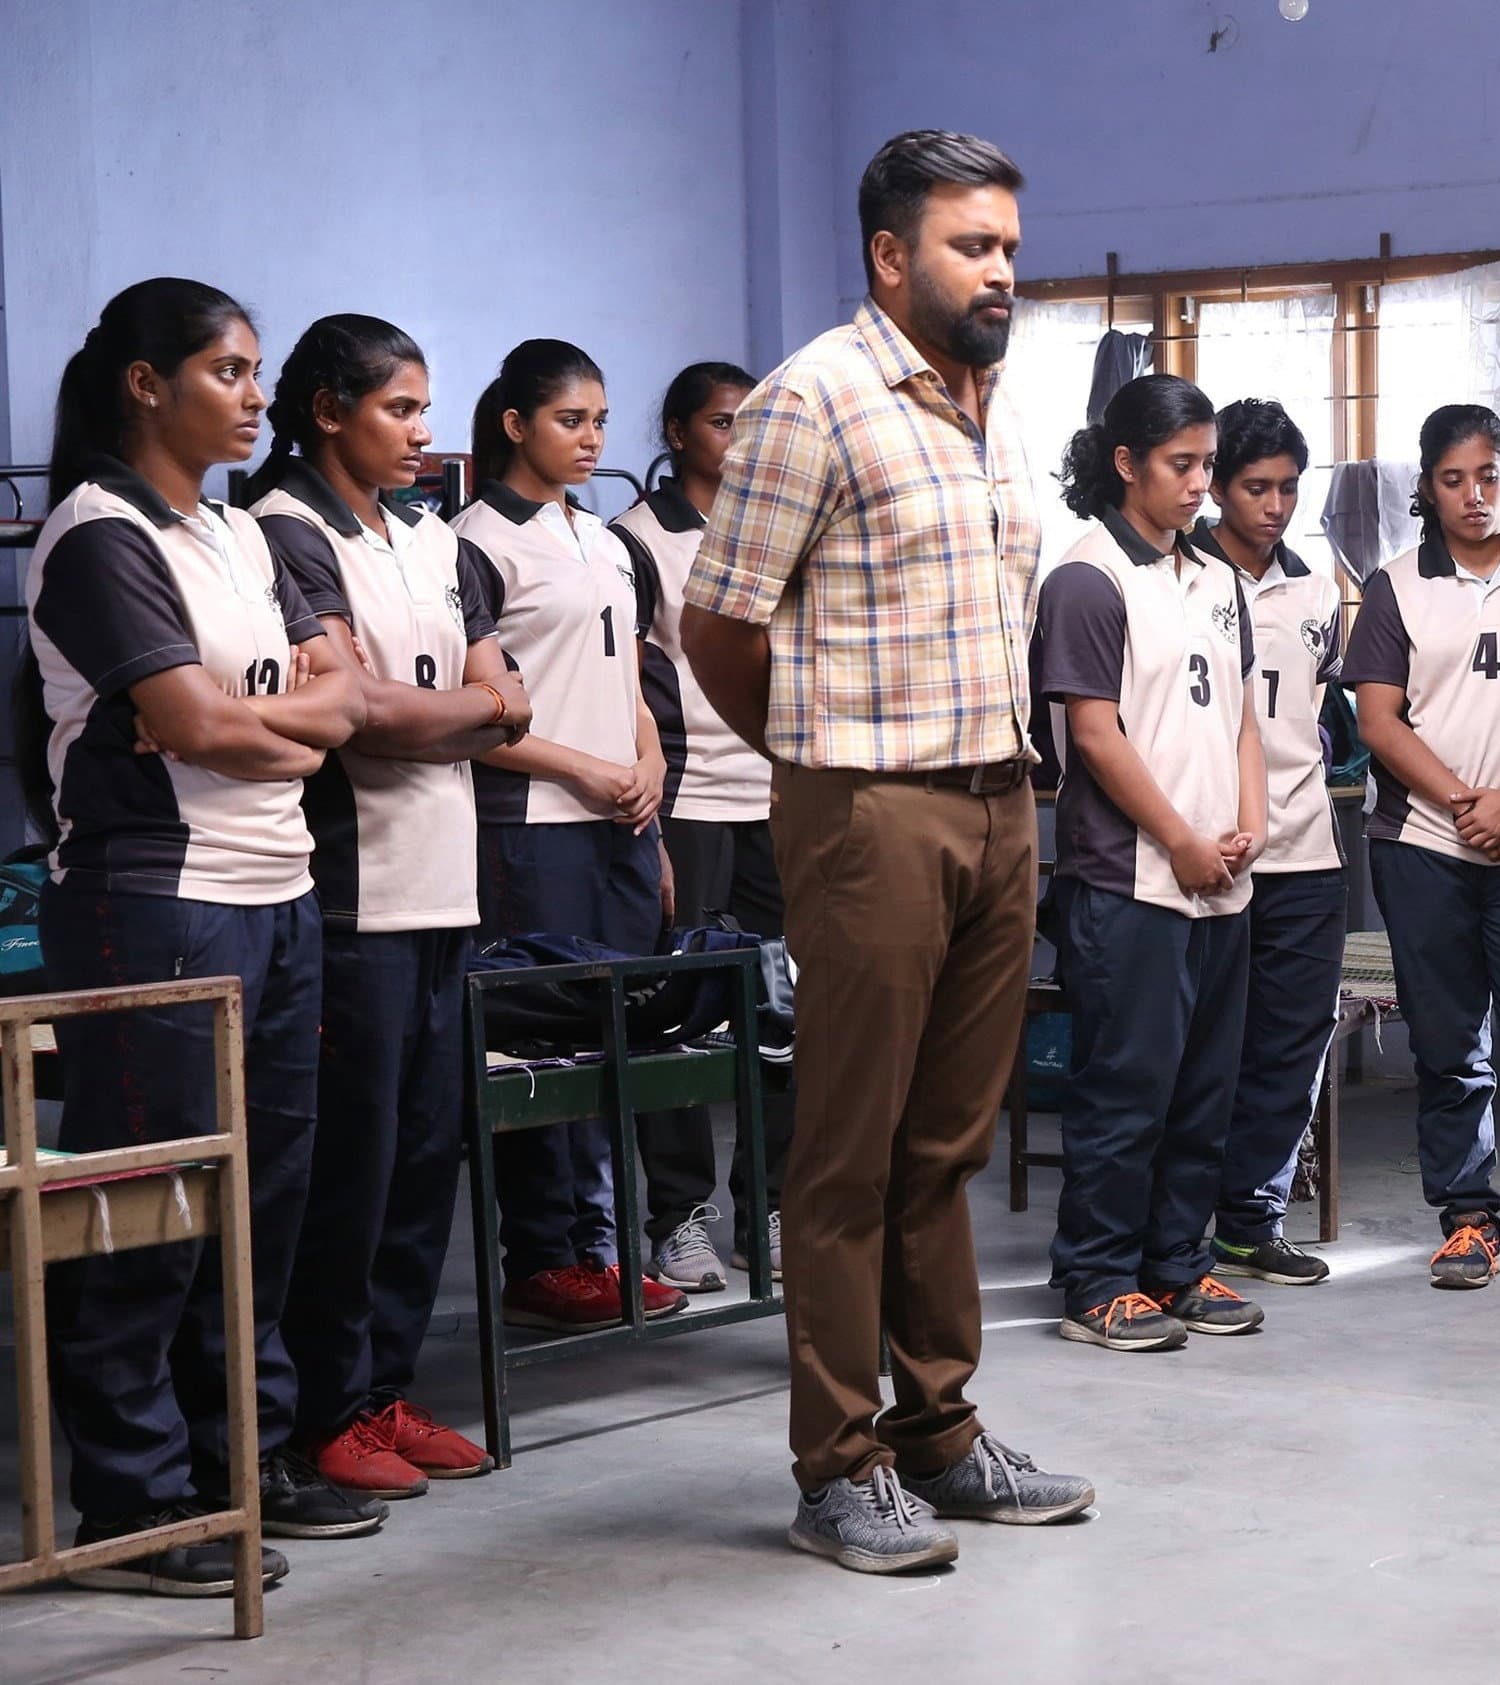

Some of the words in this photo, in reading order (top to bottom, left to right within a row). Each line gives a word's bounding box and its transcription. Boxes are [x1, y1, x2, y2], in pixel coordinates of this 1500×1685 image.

[600, 605, 616, 657] 1
[1472, 631, 1500, 680] 4
[1189, 653, 1211, 707] 3
[1261, 669, 1280, 719] 7
